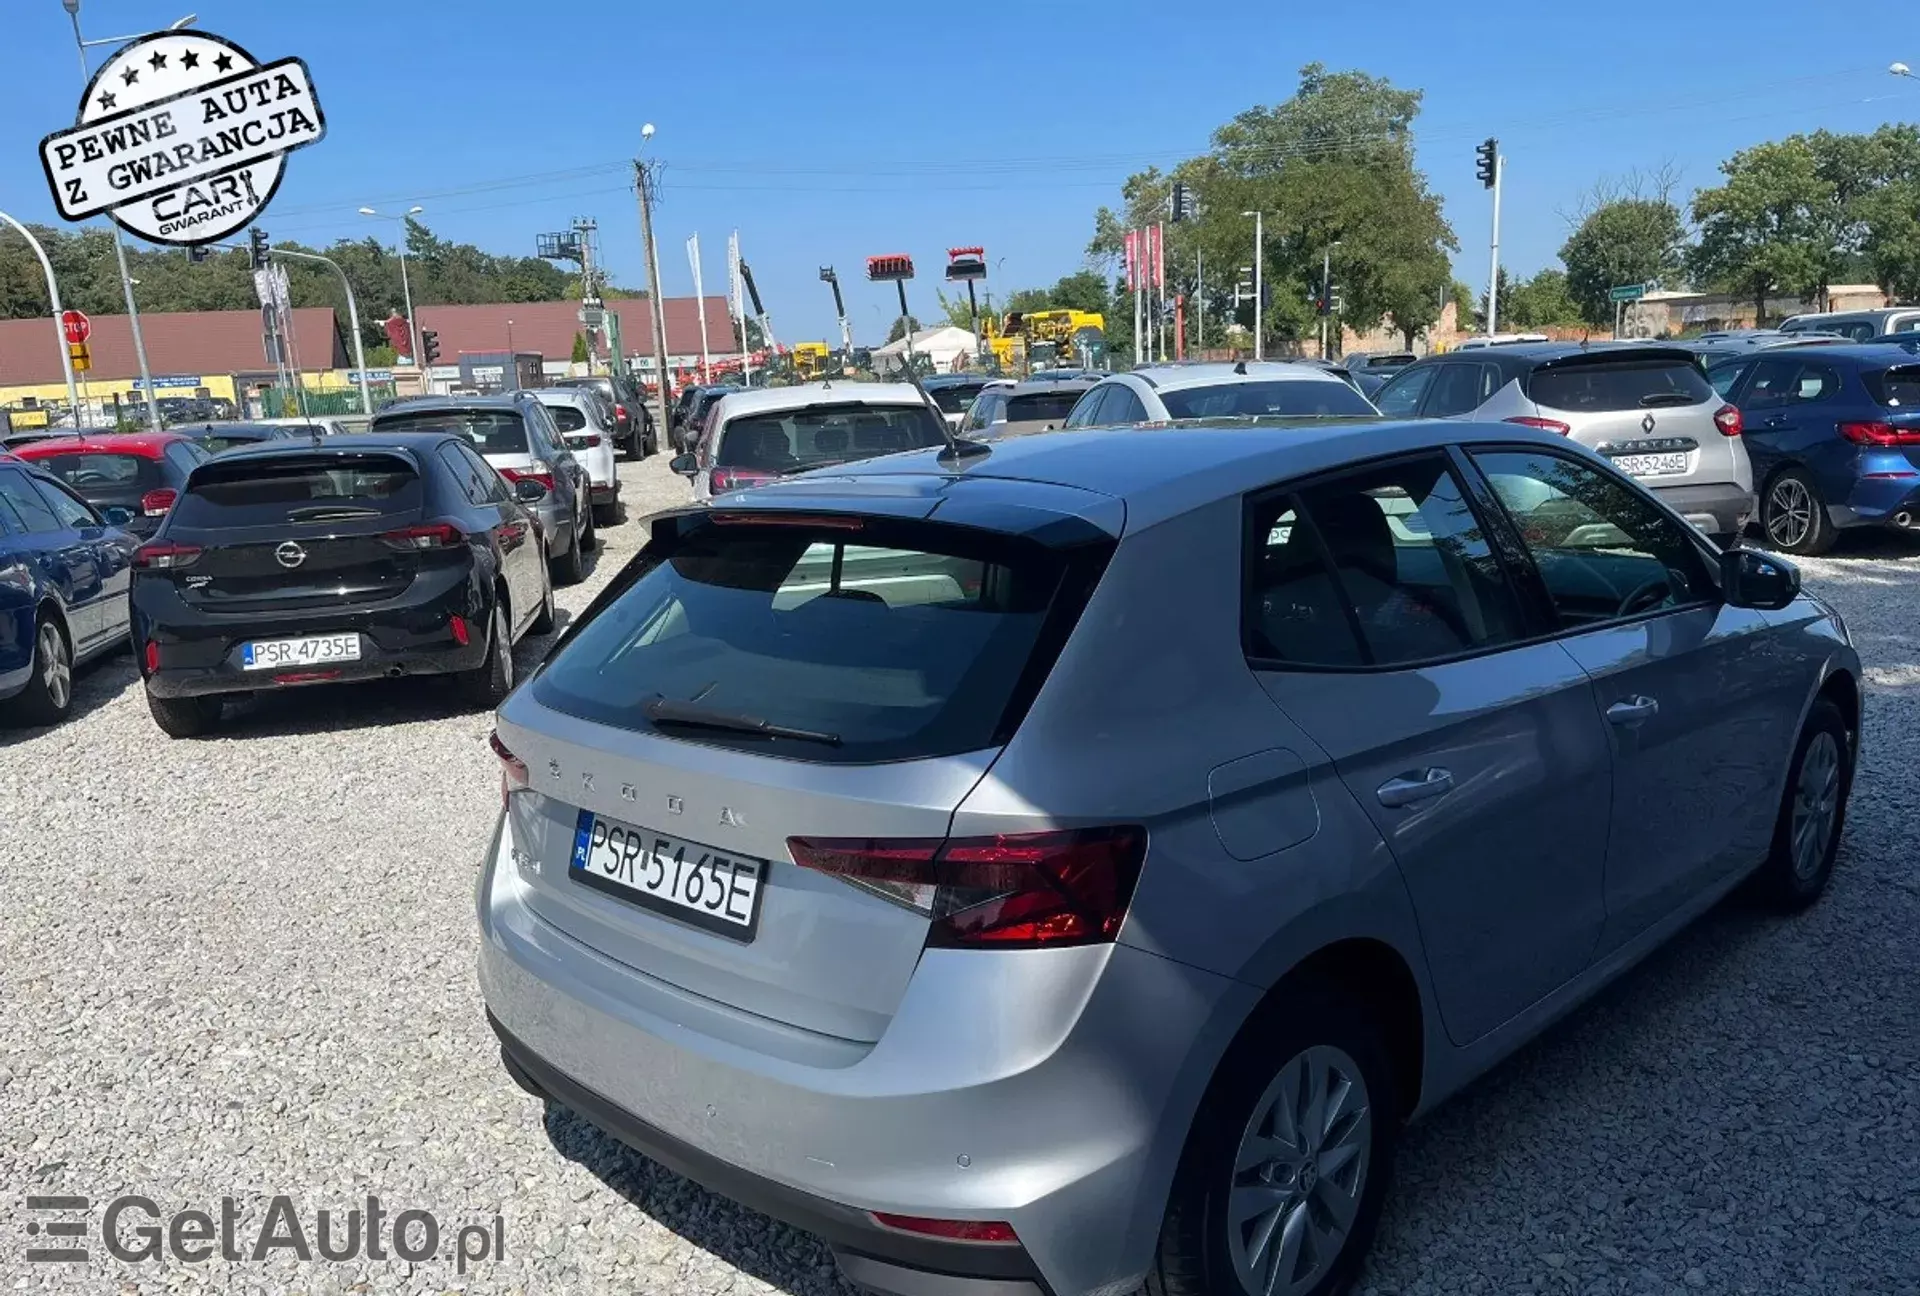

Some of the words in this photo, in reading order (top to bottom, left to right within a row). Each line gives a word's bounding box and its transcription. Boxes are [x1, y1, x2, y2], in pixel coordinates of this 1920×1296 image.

[1643, 453, 1685, 471] 5246E
[254, 643, 291, 663] PSR
[298, 636, 357, 660] 4735E
[588, 819, 641, 882] PSR
[646, 838, 755, 920] 5165E
